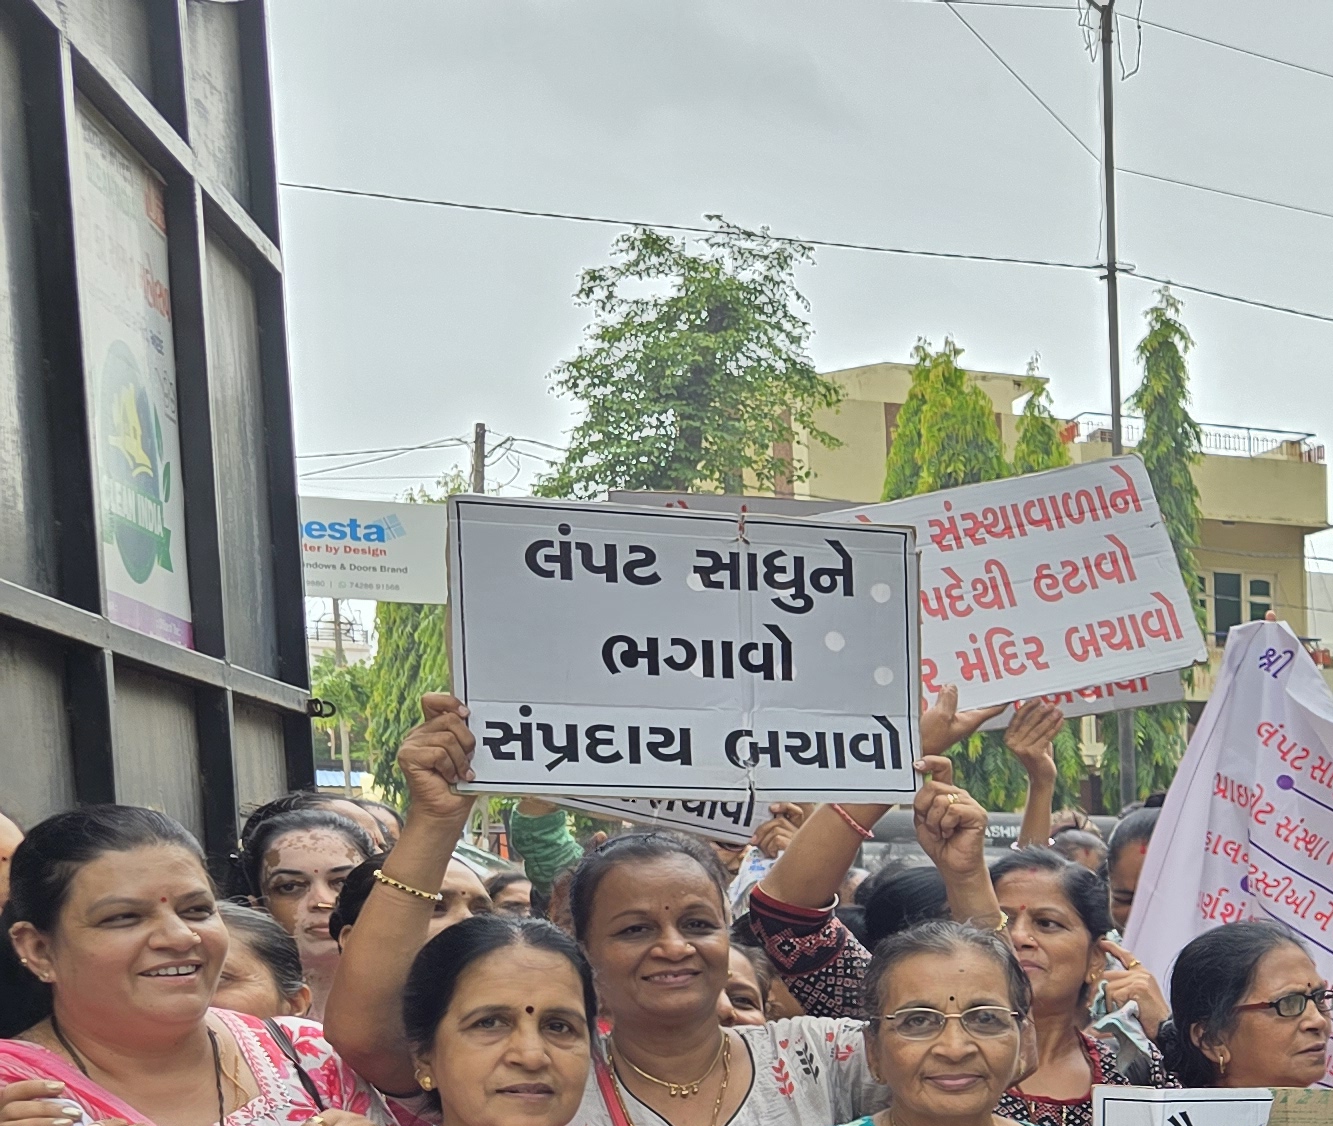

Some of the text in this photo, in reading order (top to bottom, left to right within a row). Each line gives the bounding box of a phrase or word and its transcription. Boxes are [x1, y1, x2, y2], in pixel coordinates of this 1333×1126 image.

[301, 518, 386, 543] esta
[928, 464, 1143, 553] સંસ્થાવાળાને
[325, 544, 387, 558] by Design
[339, 563, 346, 571] &
[349, 563, 377, 573] Doors
[380, 565, 408, 574] Brand
[524, 522, 854, 615] લંપટ સાધુને
[1033, 533, 1138, 603] હટાવો
[601, 623, 793, 683] ભગાવો
[956, 591, 1184, 685] મંદિર બચાવો
[1259, 646, 1295, 680] શ્રી
[482, 704, 903, 773] સંપ્રદાય બચાવો
[1257, 722, 1310, 771] લંપટ
[1275, 816, 1330, 861] સંસ્થા
